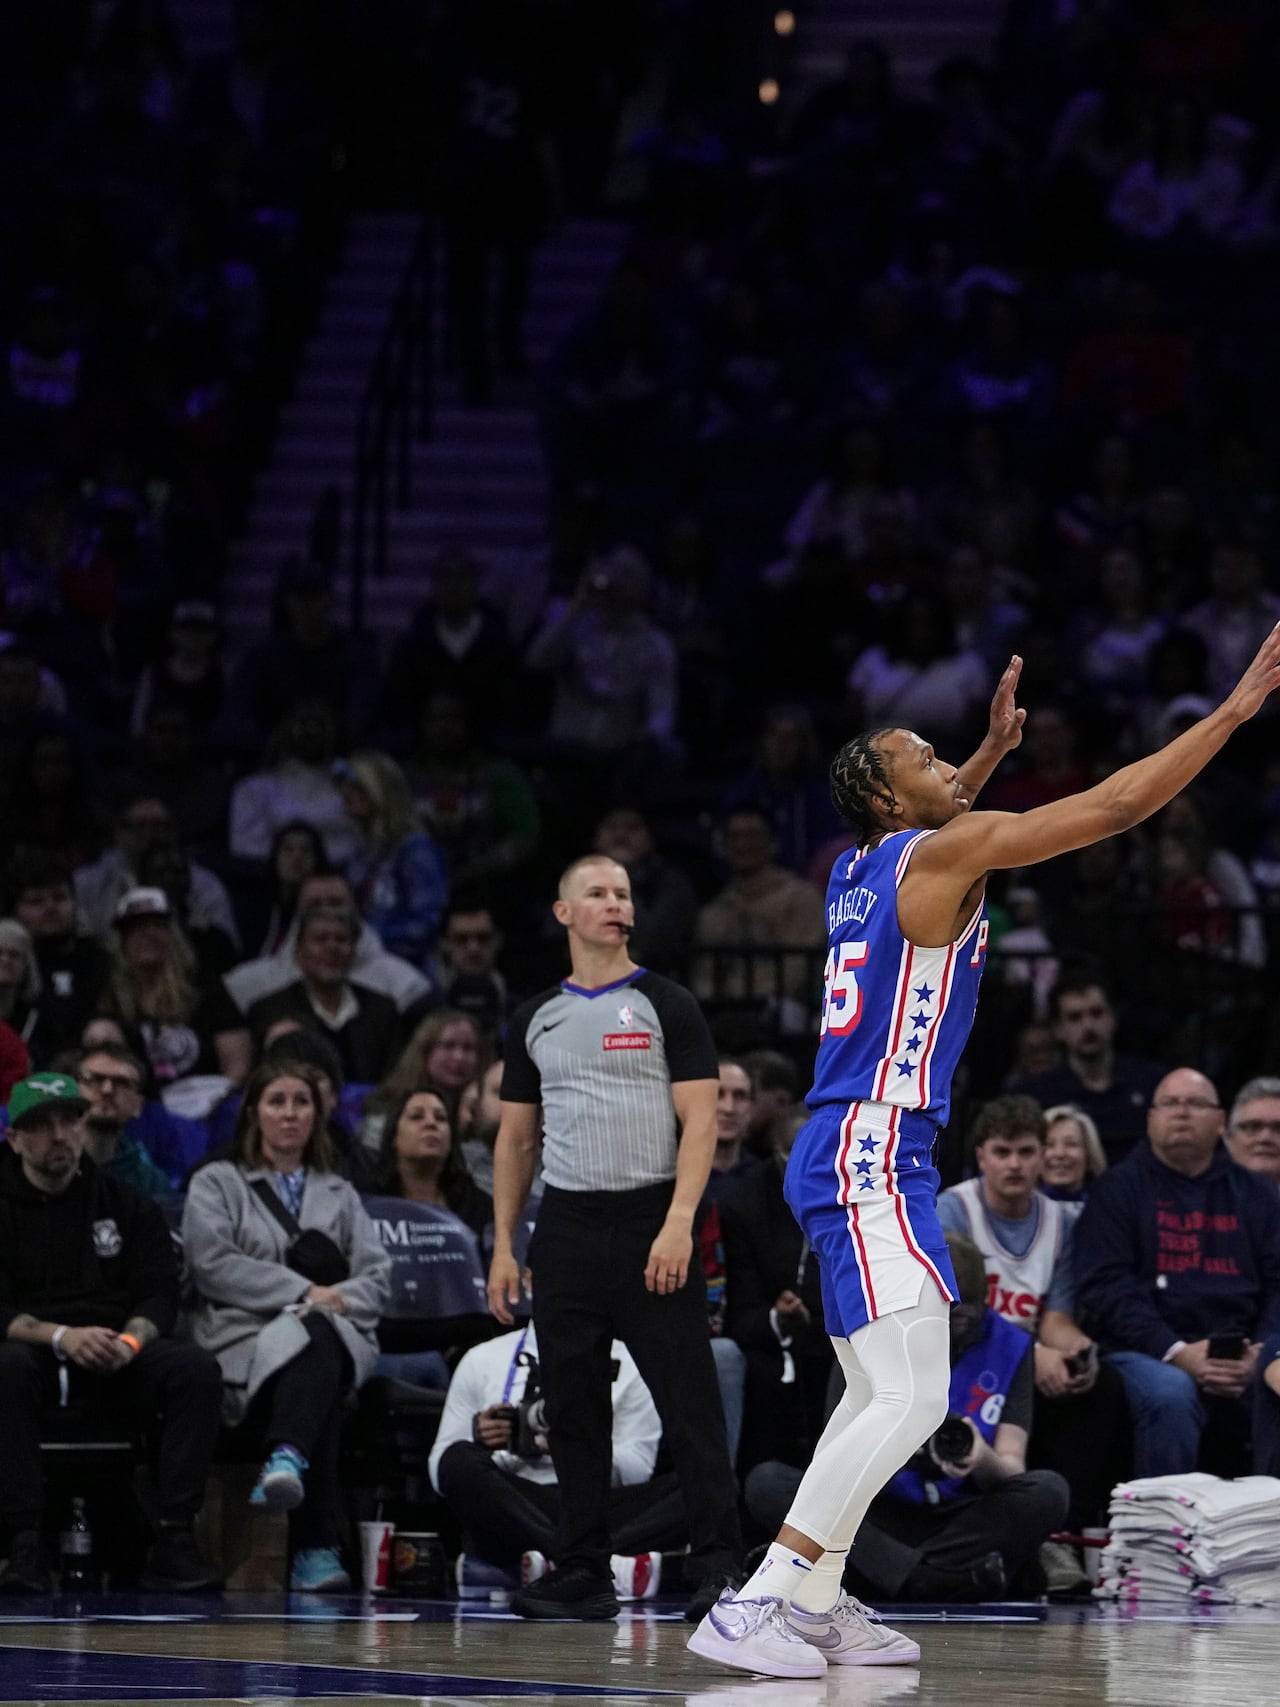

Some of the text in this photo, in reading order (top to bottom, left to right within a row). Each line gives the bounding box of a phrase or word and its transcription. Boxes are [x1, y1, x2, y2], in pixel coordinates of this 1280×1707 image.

[828, 887, 878, 935] BAGLEY
[604, 1036, 650, 1048] Emirates
[411, 1235, 446, 1248] Group
[966, 1384, 1005, 1425] 76
